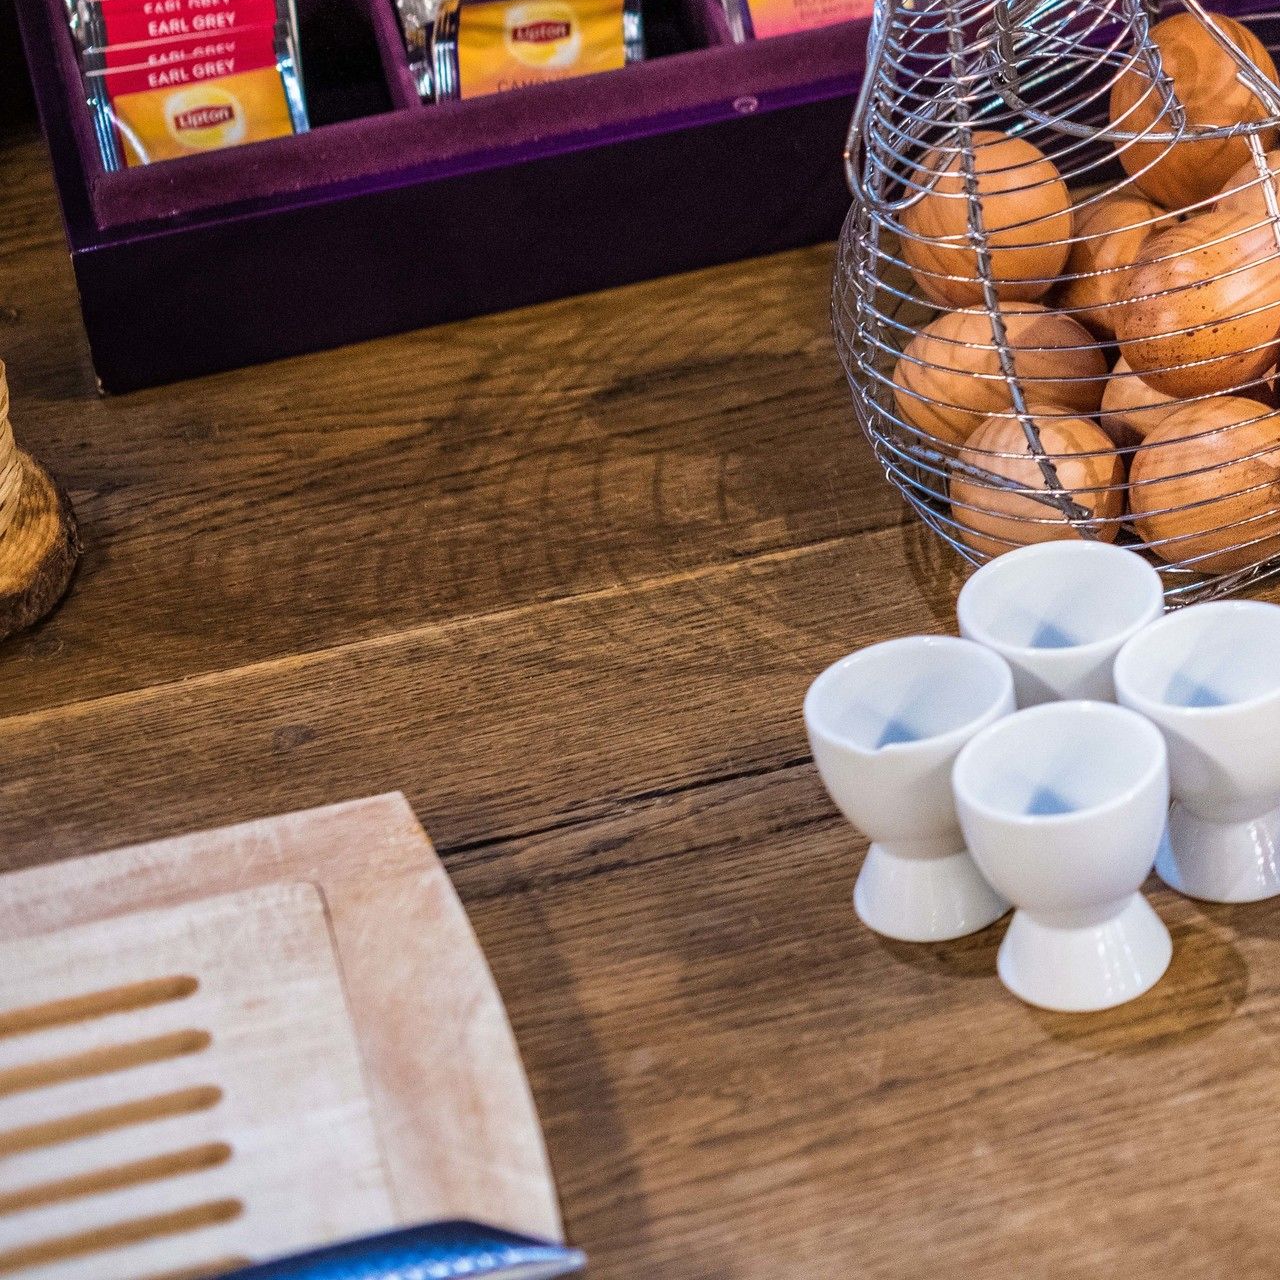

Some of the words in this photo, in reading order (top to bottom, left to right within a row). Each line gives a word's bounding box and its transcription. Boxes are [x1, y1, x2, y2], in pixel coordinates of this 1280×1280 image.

[147, 17, 190, 37] EARL
[192, 11, 236, 31] GREY
[514, 22, 567, 41] Lipton
[147, 67, 190, 88] EARL
[192, 58, 235, 79] GREY
[179, 107, 231, 128] Lipton
